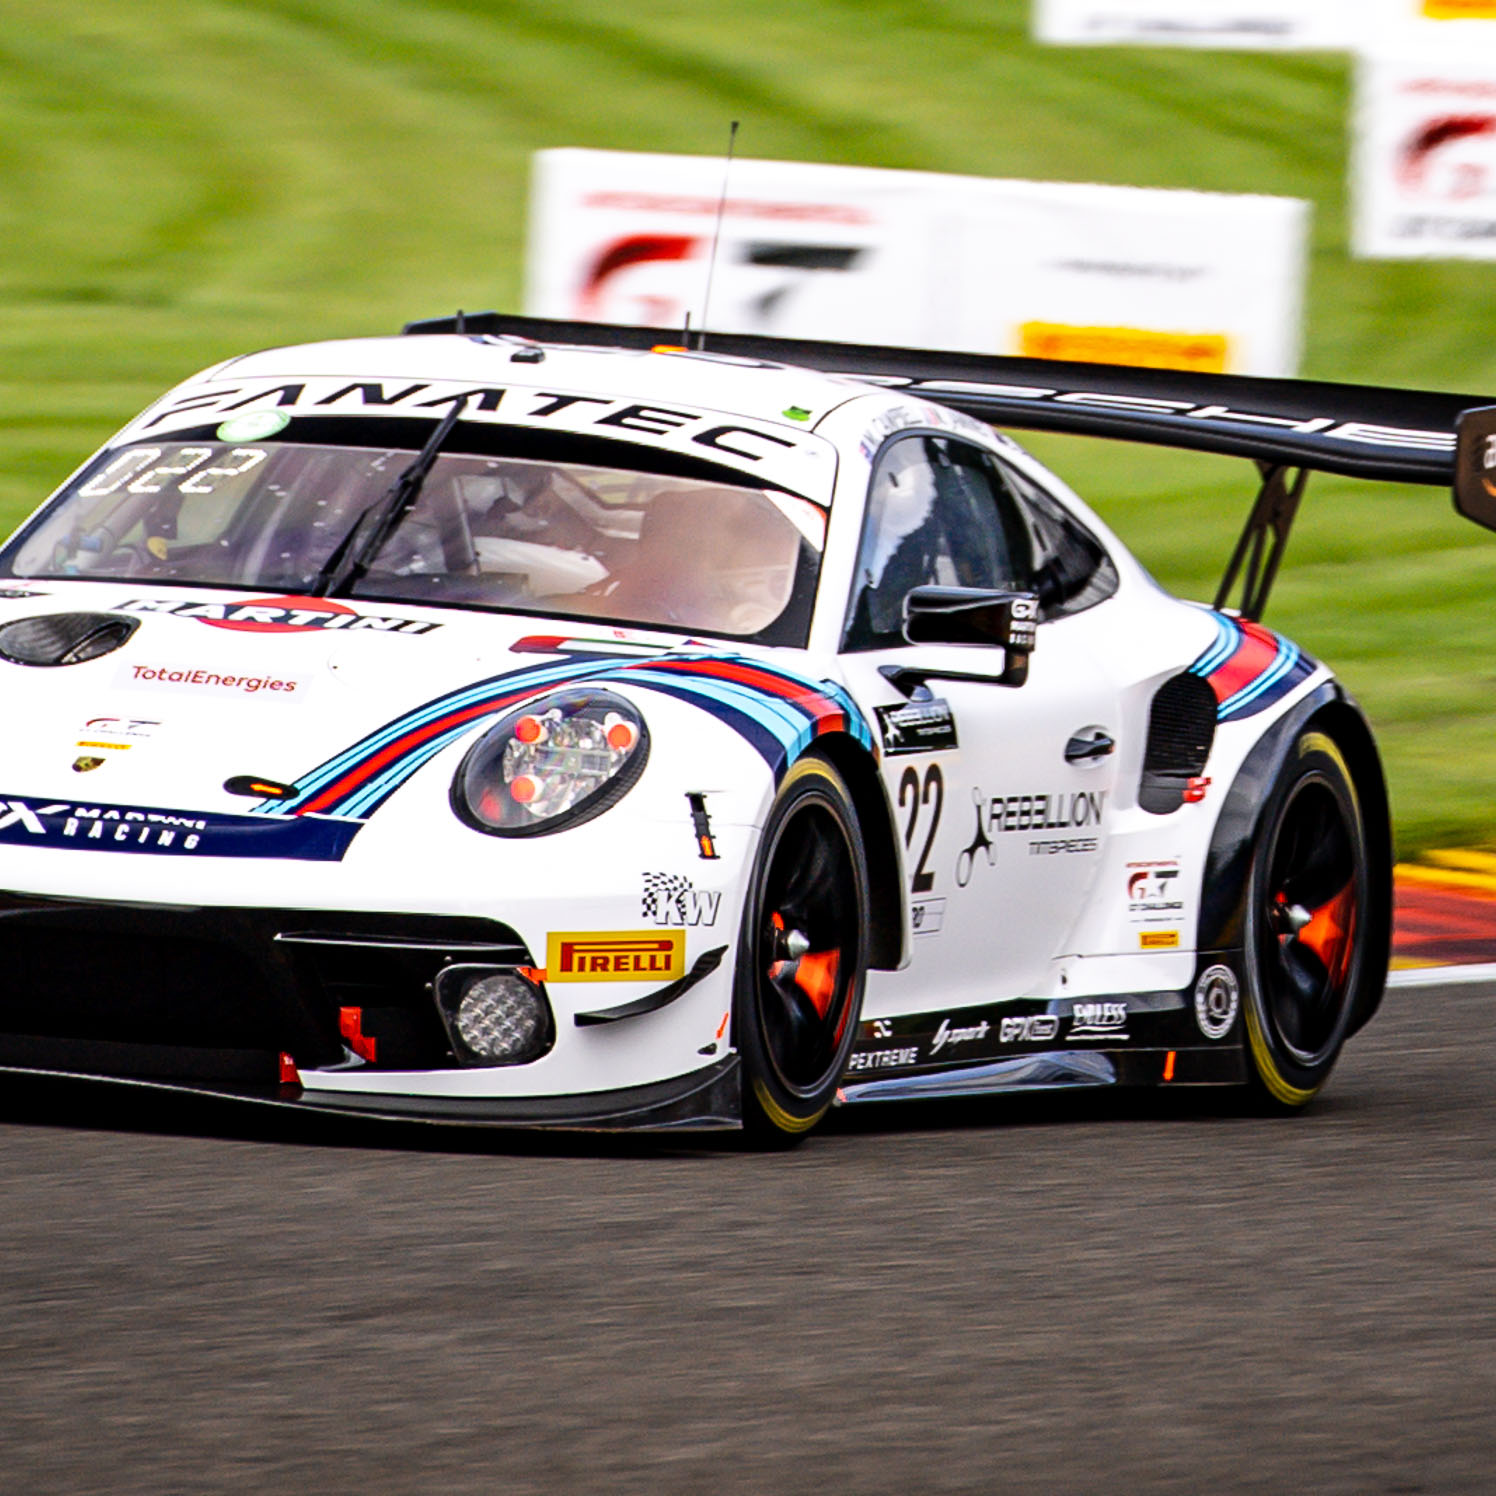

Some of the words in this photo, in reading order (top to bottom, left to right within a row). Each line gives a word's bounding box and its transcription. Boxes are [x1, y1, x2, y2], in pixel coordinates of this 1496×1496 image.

[142, 382, 797, 461] FANATEC
[78, 447, 268, 498] 022
[111, 598, 446, 635] MARTINI
[131, 665, 298, 693] TotalEnergies
[988, 791, 1106, 832] REBELLION
[63, 817, 202, 850] RACING
[655, 889, 721, 927] KW
[560, 940, 673, 972] PIRELLI
[848, 1047, 919, 1070] PEXTREME
